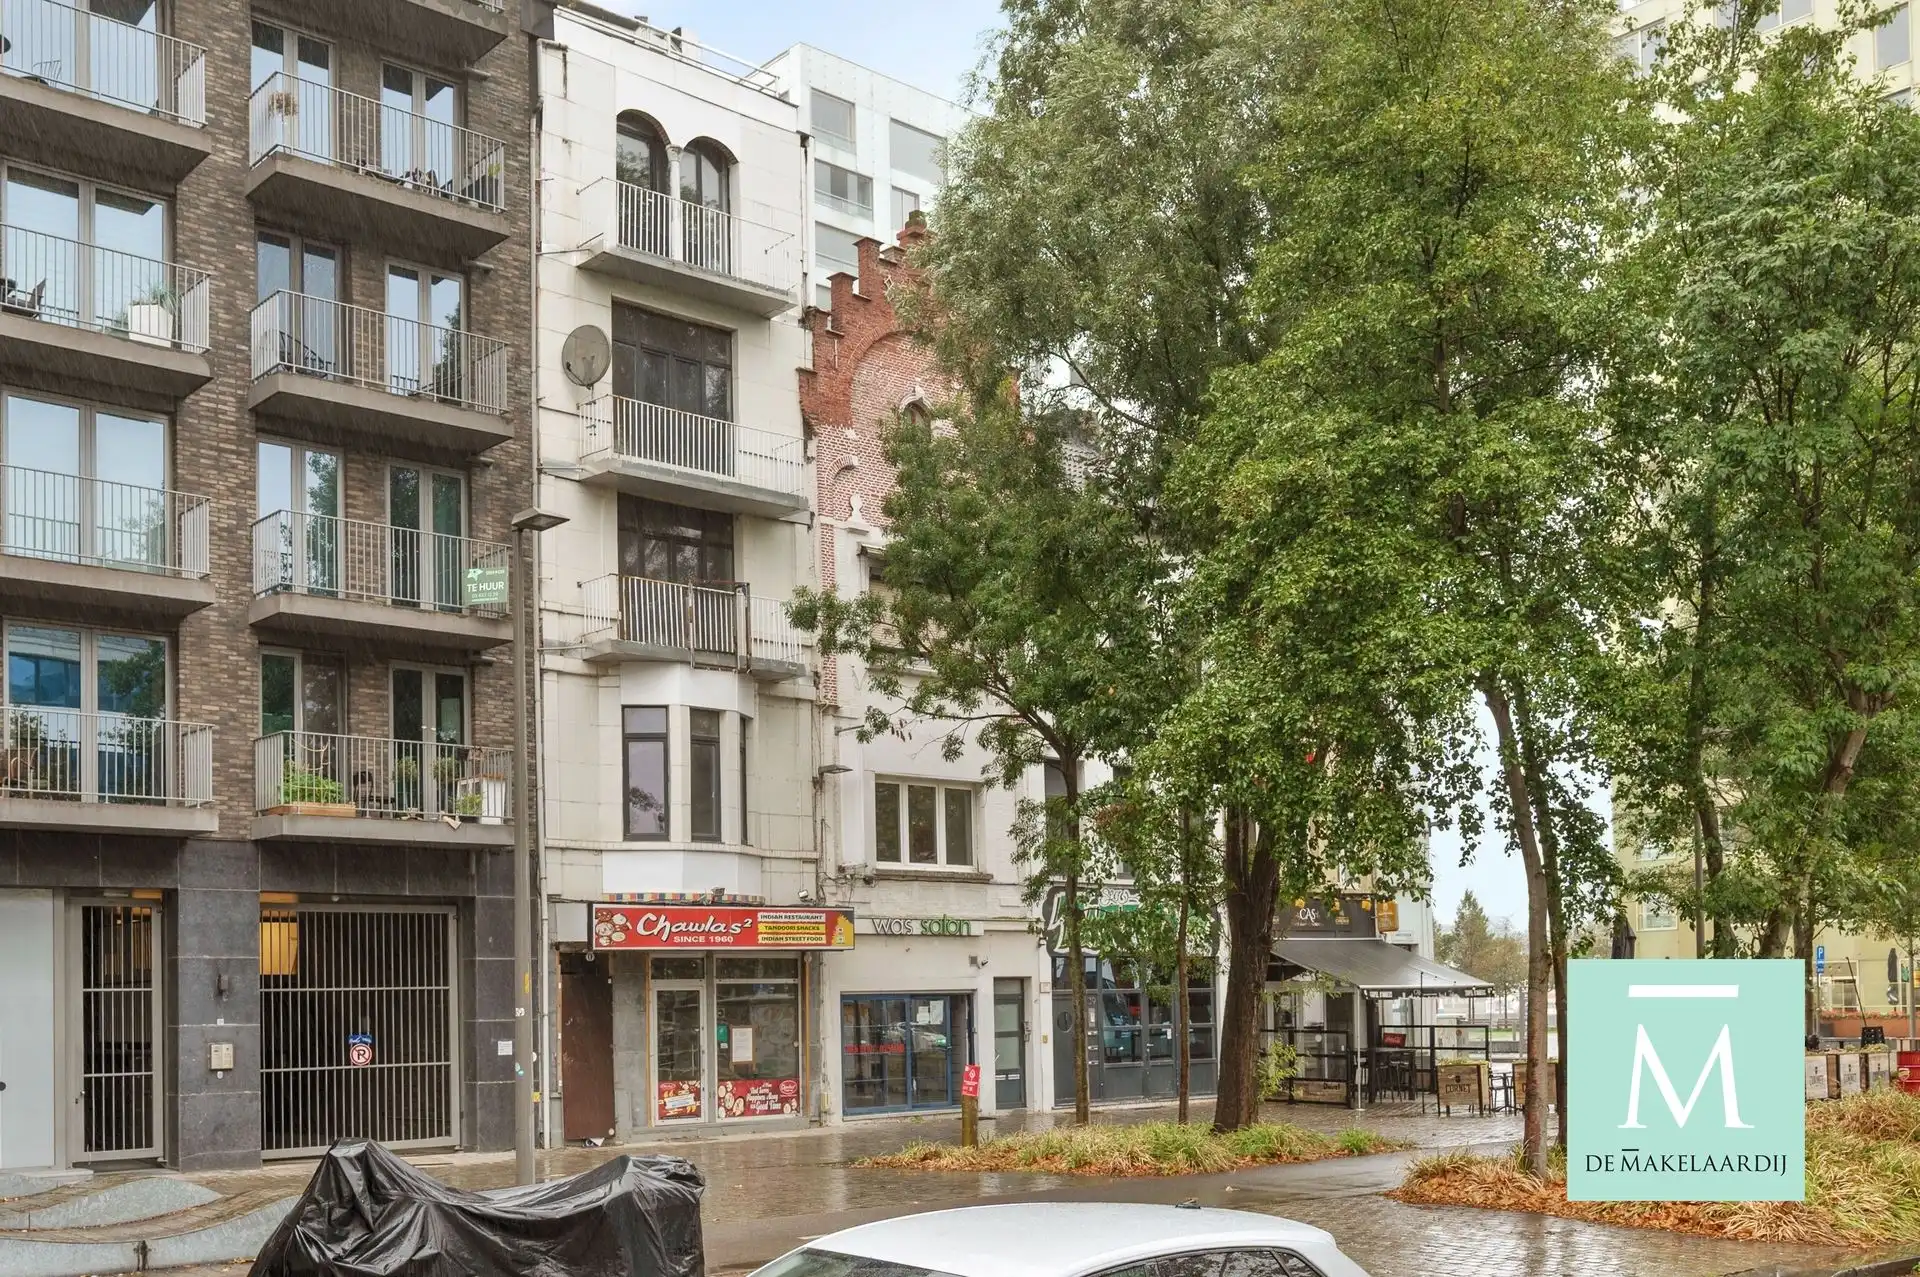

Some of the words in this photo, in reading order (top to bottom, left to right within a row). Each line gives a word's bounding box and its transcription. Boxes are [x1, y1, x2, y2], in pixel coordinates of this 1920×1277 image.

[467, 583, 477, 592] TE
[479, 581, 504, 591] HUUR
[1299, 907, 1316, 922] CAS
[871, 918, 913, 936] was
[920, 913, 972, 936] salon
[673, 935, 705, 943] SINCE
[708, 935, 734, 943] 1960
[1818, 947, 1823, 958] P
[1445, 1083, 1471, 1094] CORNET
